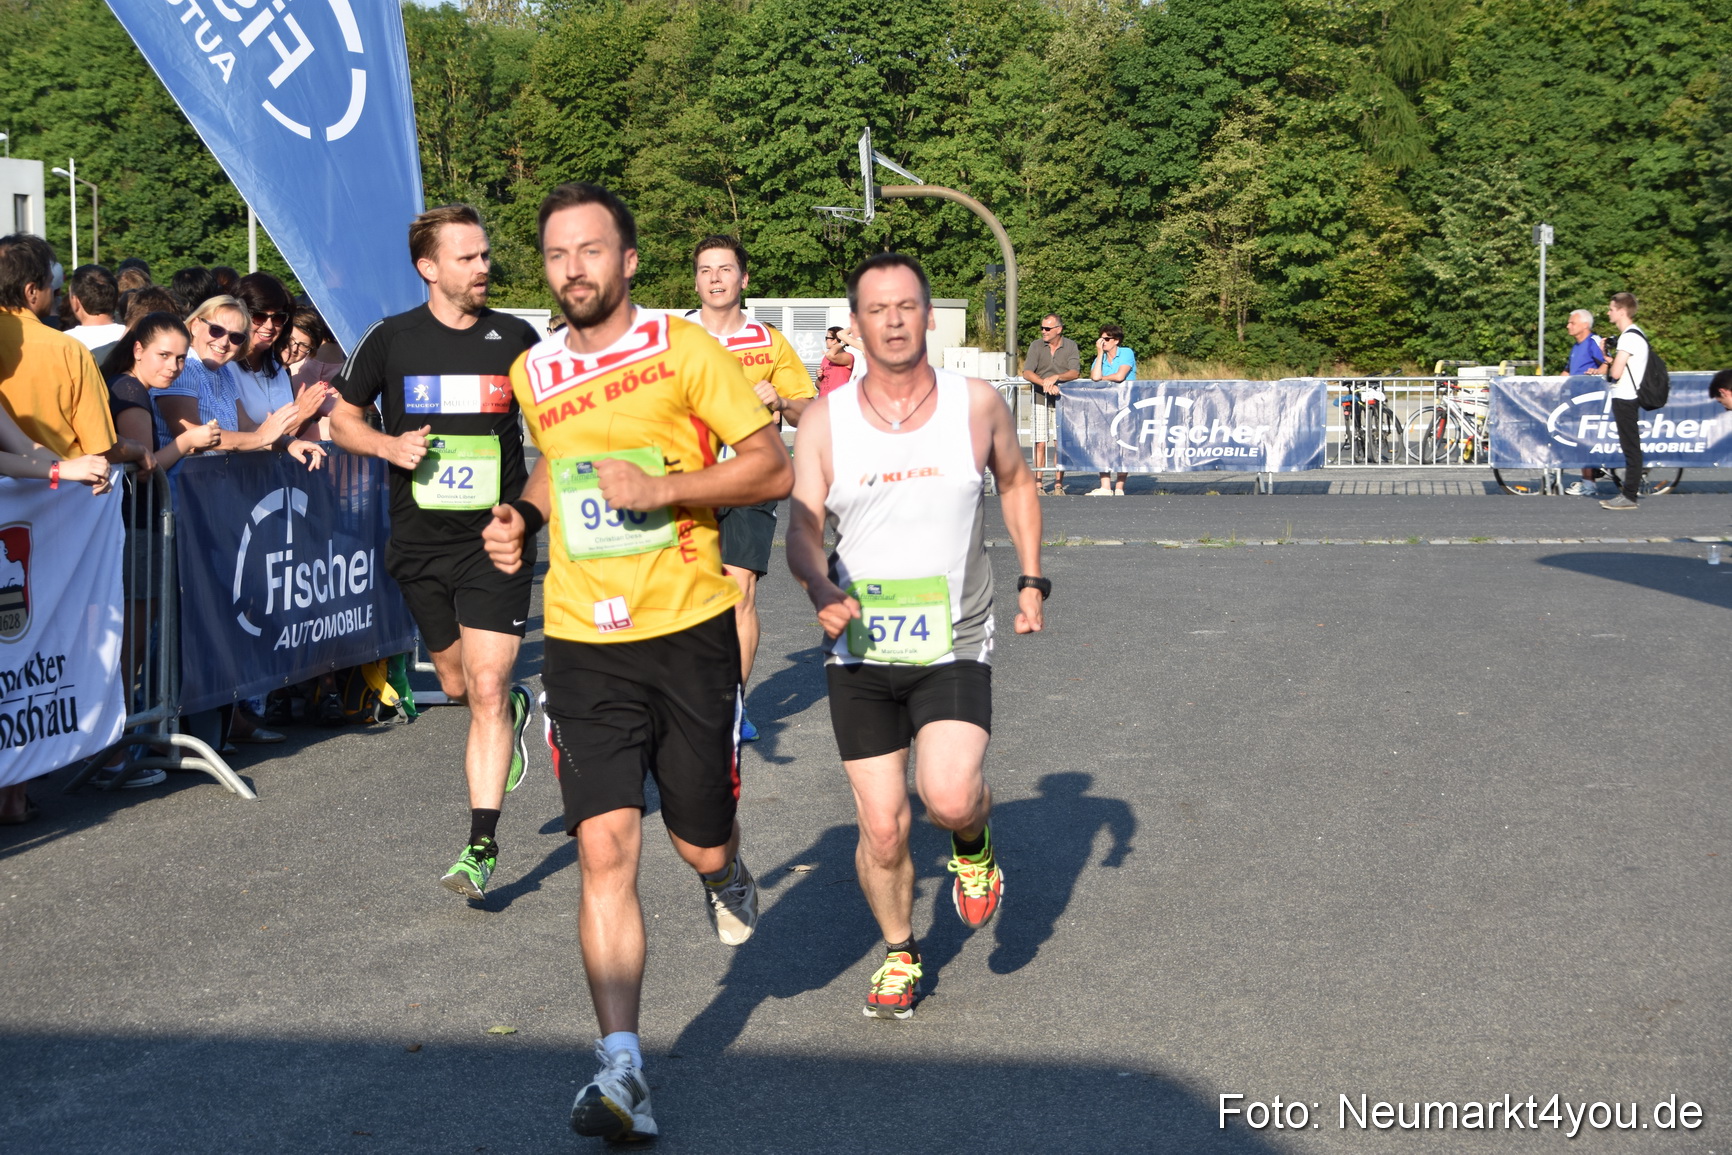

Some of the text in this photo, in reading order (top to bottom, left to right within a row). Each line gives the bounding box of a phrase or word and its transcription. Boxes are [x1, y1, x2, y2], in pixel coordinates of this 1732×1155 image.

[538, 361, 676, 432] MAX BÖGL
[1139, 418, 1270, 444] Fischer
[1150, 446, 1259, 458] AUTOMOBILE
[438, 465, 474, 489] 42
[882, 467, 945, 483] KLEBL
[273, 603, 373, 651] AUTOMOBILE
[867, 614, 931, 643] 574
